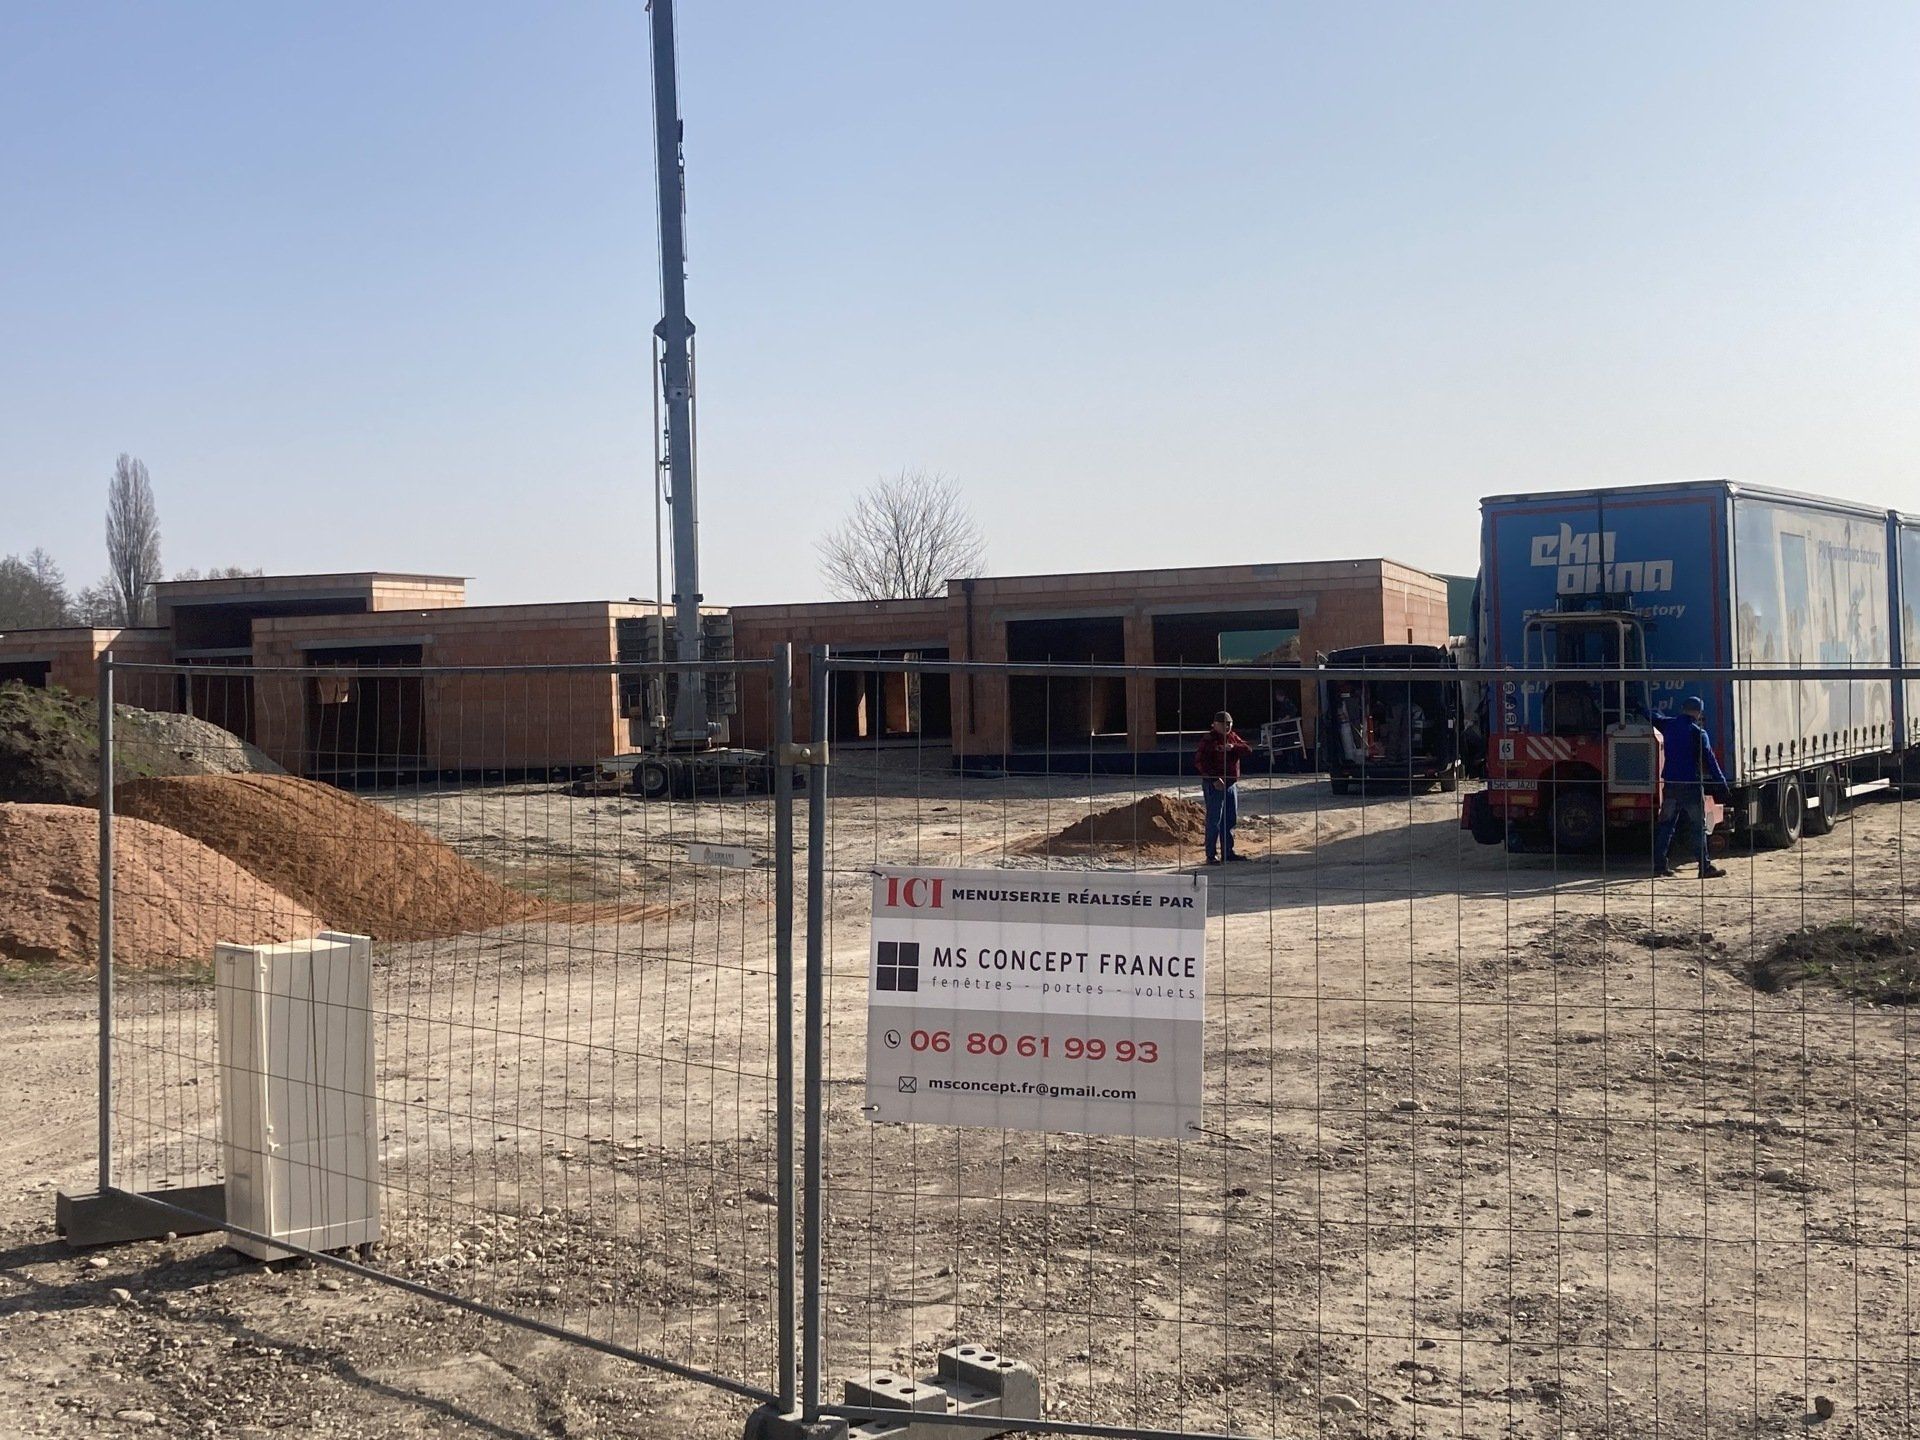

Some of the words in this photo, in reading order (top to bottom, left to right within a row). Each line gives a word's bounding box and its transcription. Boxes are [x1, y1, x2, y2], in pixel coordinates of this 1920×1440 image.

[885, 877, 945, 909] ICI
[952, 888, 1061, 904] MENUISERIE
[1067, 888, 1152, 907] RÉALISÉE
[1159, 896, 1194, 909] PAR
[933, 947, 967, 968] MS
[978, 948, 1089, 974] CONCEPT
[1100, 953, 1196, 978] FRANCE
[932, 975, 1012, 991] fenêtres
[1042, 982, 1104, 995] portes
[1135, 985, 1195, 999] volets
[910, 1030, 951, 1053] 06
[966, 1032, 1008, 1056] 80
[1016, 1035, 1050, 1058] 61
[1064, 1037, 1107, 1061] 99
[1115, 1040, 1159, 1064] 93
[928, 1077, 1137, 1100] msconcept.fr@gmail.com
